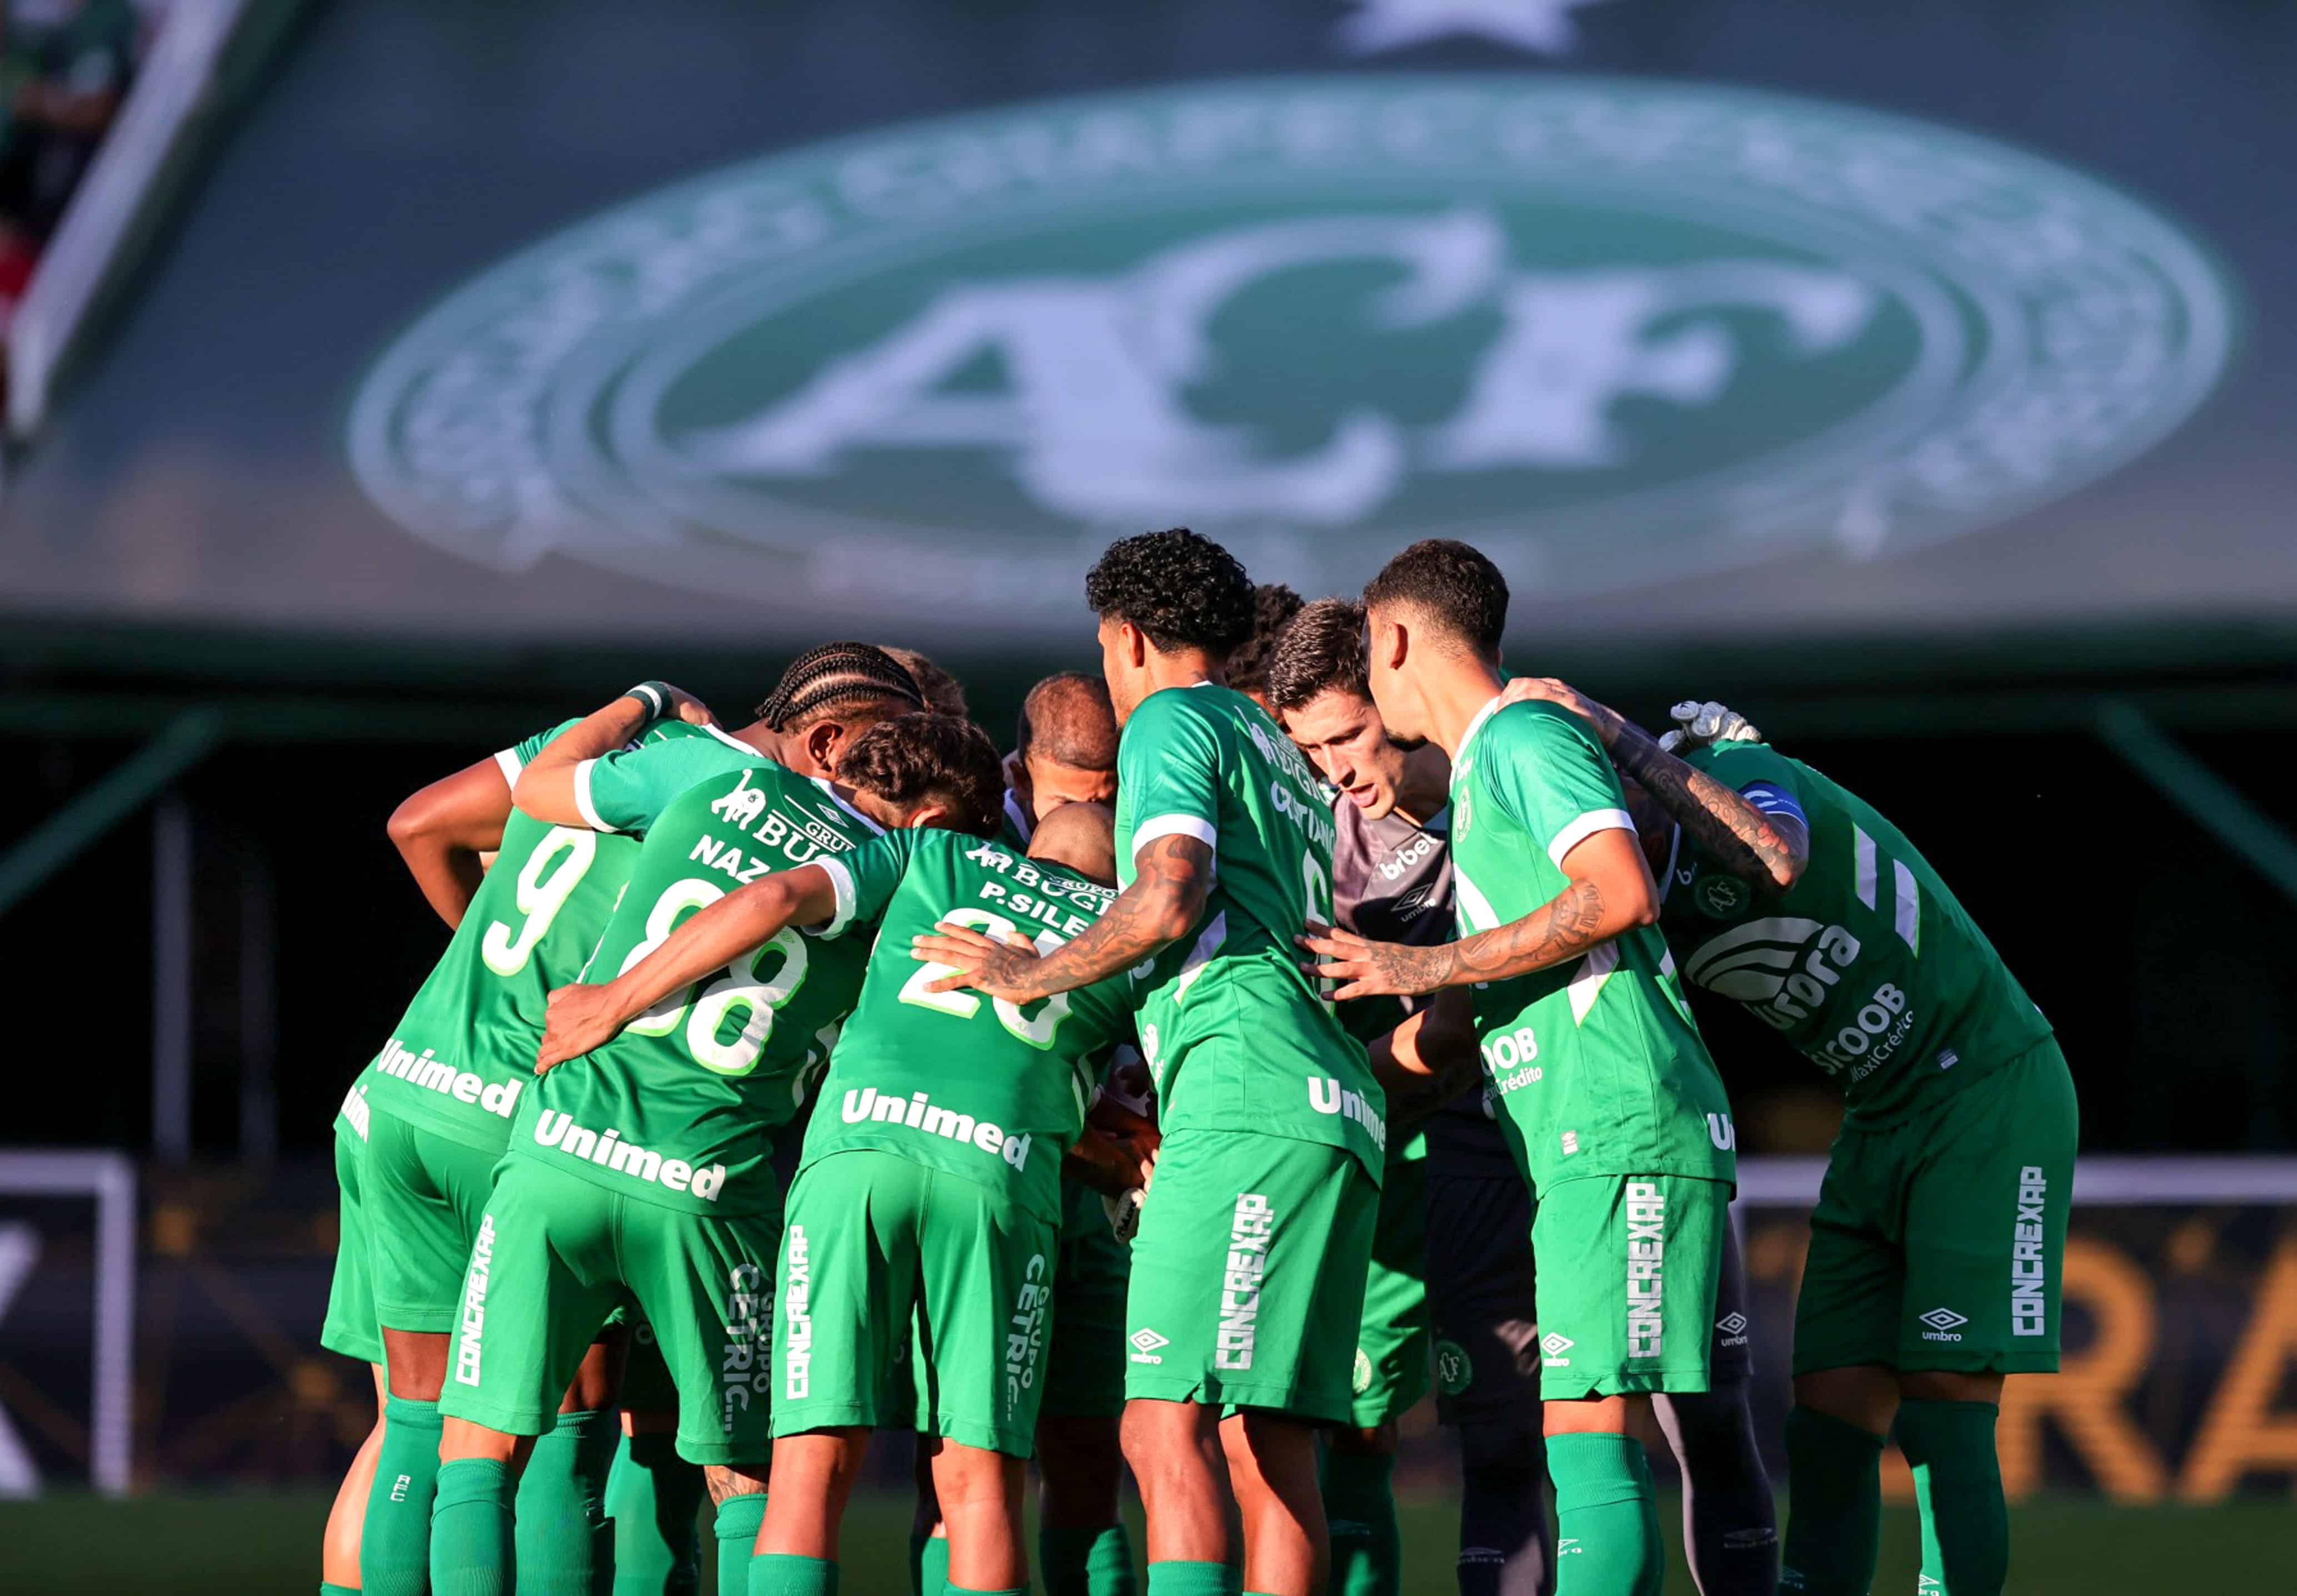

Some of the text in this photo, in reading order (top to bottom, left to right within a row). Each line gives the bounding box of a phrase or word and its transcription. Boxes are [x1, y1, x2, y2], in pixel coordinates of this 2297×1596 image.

[482, 822, 596, 976] 9
[1401, 897, 1436, 922] umbro
[618, 878, 809, 1075] 88
[1740, 924, 1861, 1031] urora
[376, 1038, 523, 1119] Unimed
[533, 1109, 726, 1202] Unimed
[841, 1087, 1032, 1172] Unimed
[455, 1213, 496, 1388] CONCREXAP
[785, 1225, 812, 1400] CONCREXAP
[1215, 1193, 1274, 1370] CONCREXAP
[1626, 1182, 1665, 1359] CONCREXAP
[2011, 1165, 2047, 1336] CONCREXAP
[1922, 1331, 1961, 1342] umbro
